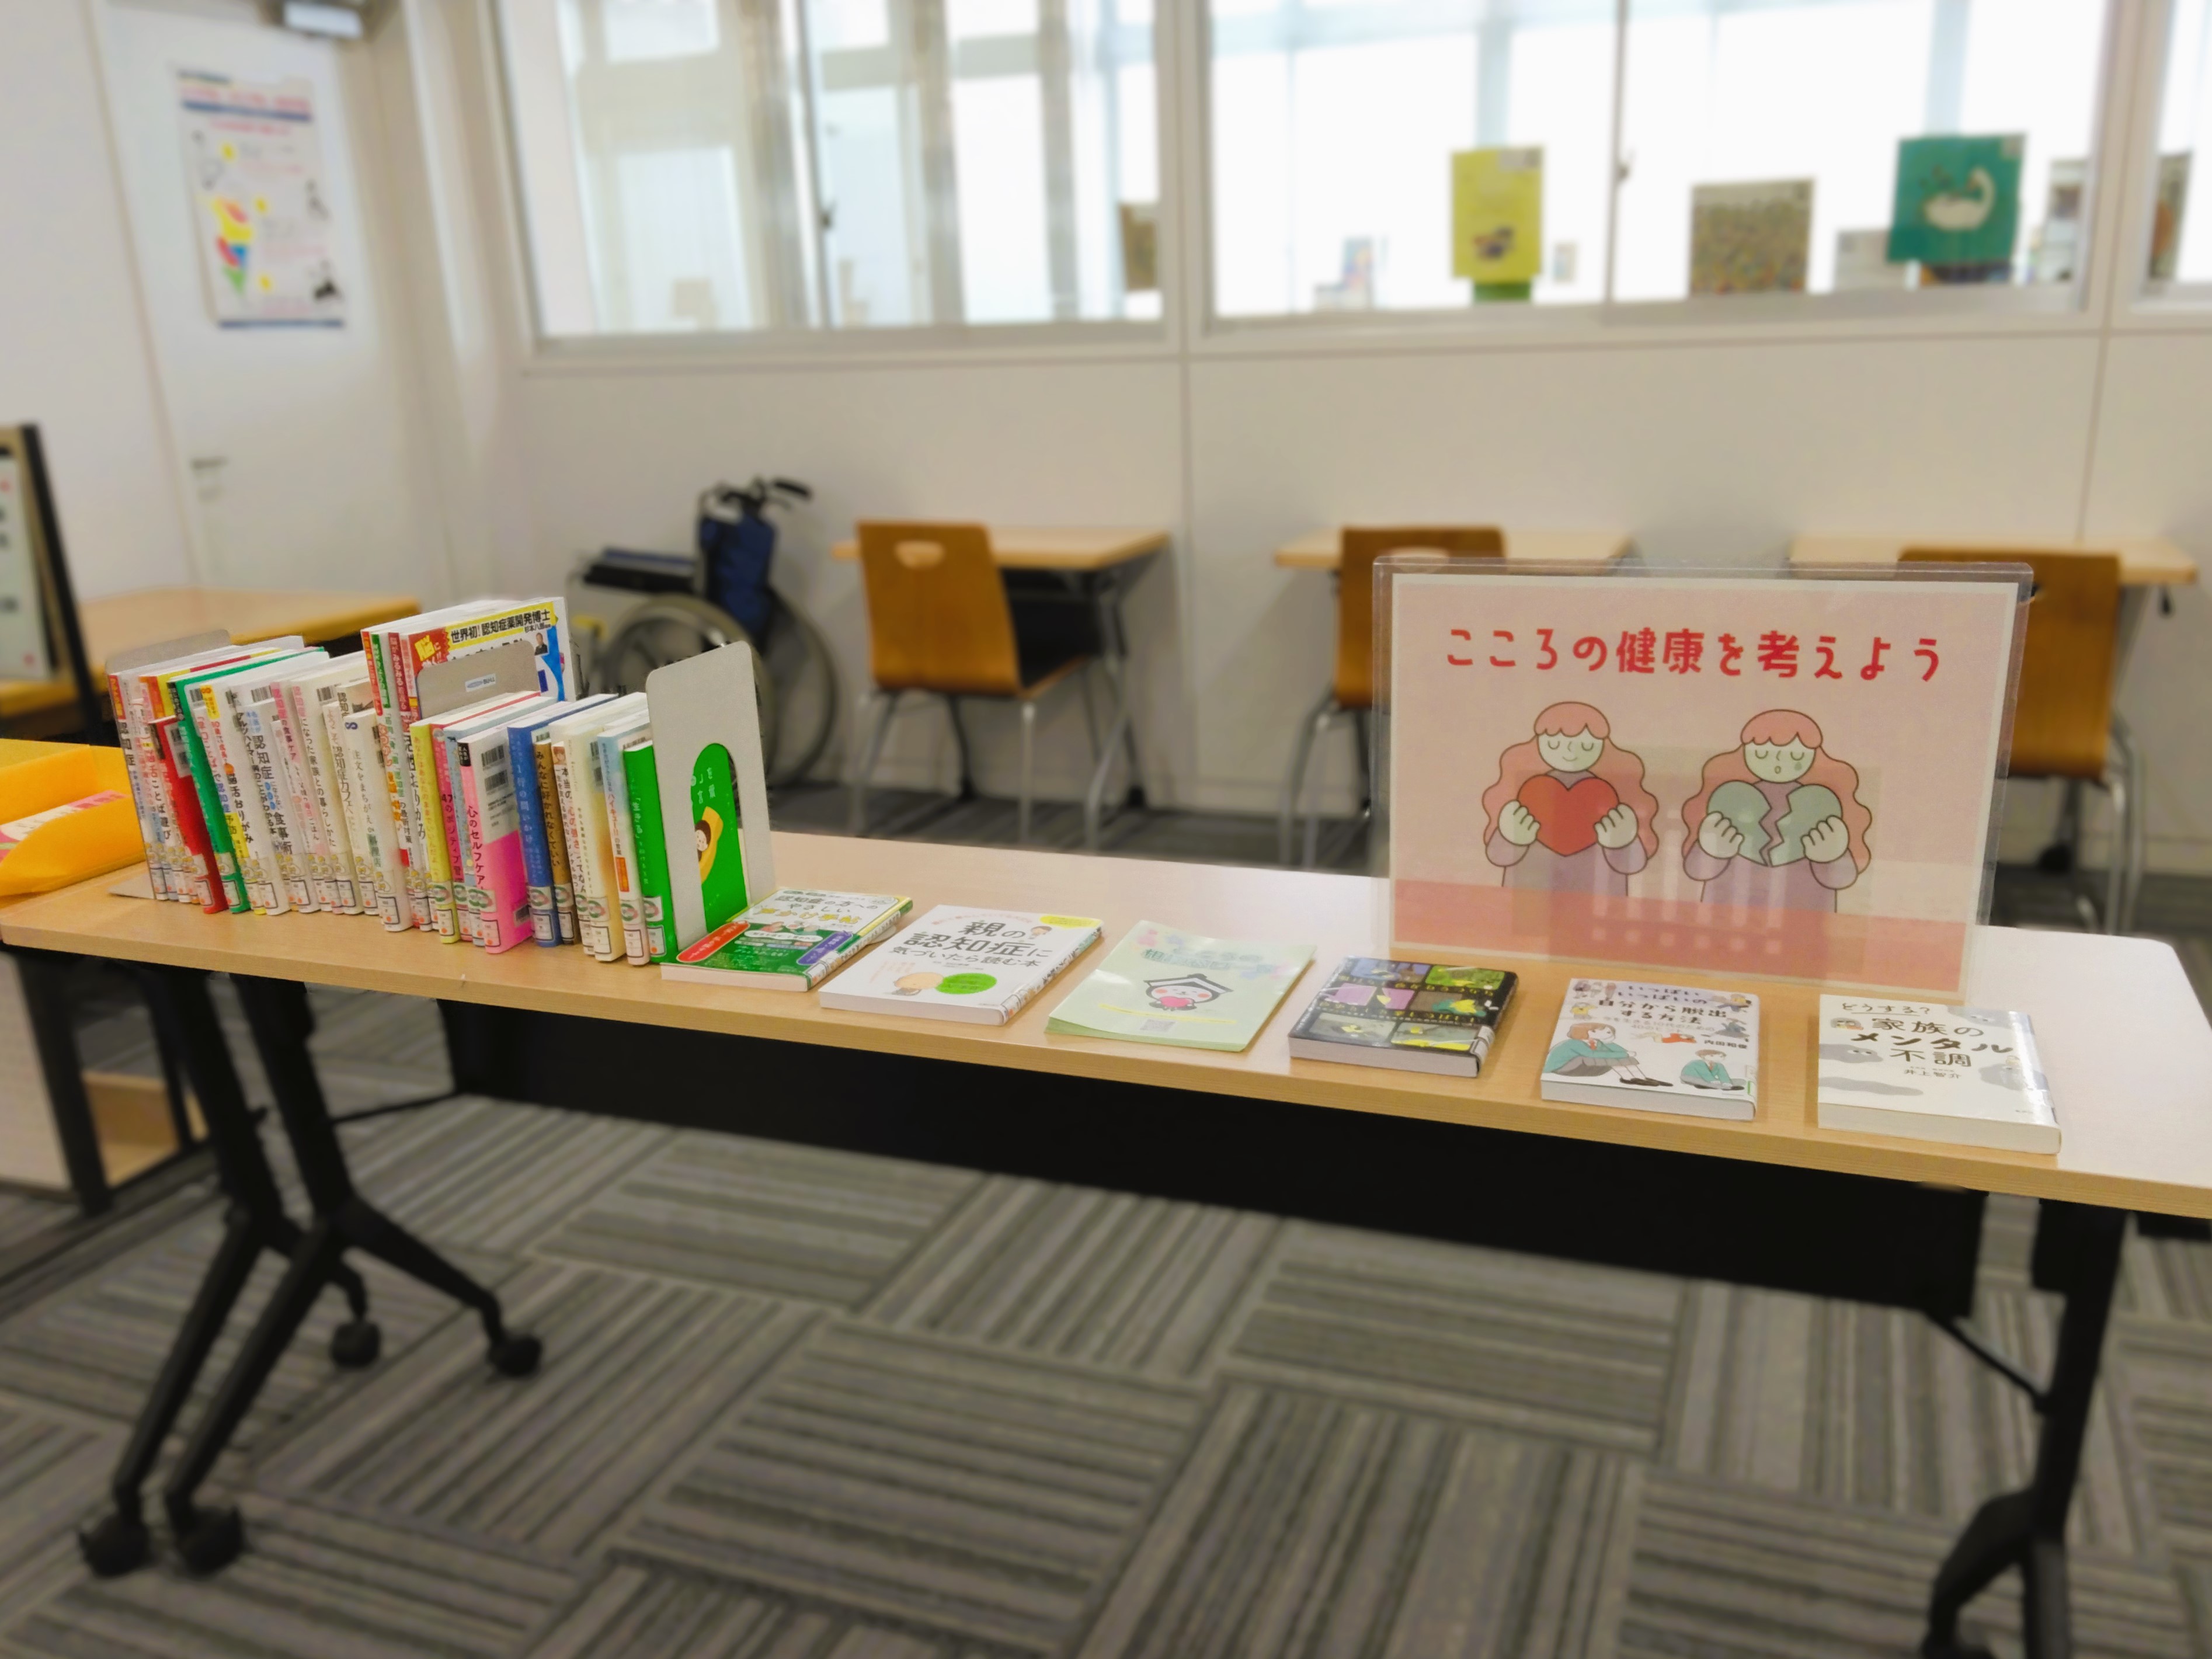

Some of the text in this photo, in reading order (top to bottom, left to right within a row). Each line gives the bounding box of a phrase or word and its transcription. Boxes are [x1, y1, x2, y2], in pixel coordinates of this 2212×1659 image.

[1446, 627, 1941, 682] こころの健康を考えよう
[252, 735, 274, 780] 認知症
[467, 805, 487, 890] 心のセルフケア
[958, 921, 1026, 939] 親の
[903, 933, 1053, 958] 認知症に
[888, 946, 1042, 968] 気づいたら読む本
[1842, 1002, 1931, 1014] どうする?
[1871, 1017, 1984, 1037] 家族の
[1850, 1032, 2014, 1053] メンタル
[1889, 1048, 1972, 1068] 不調
